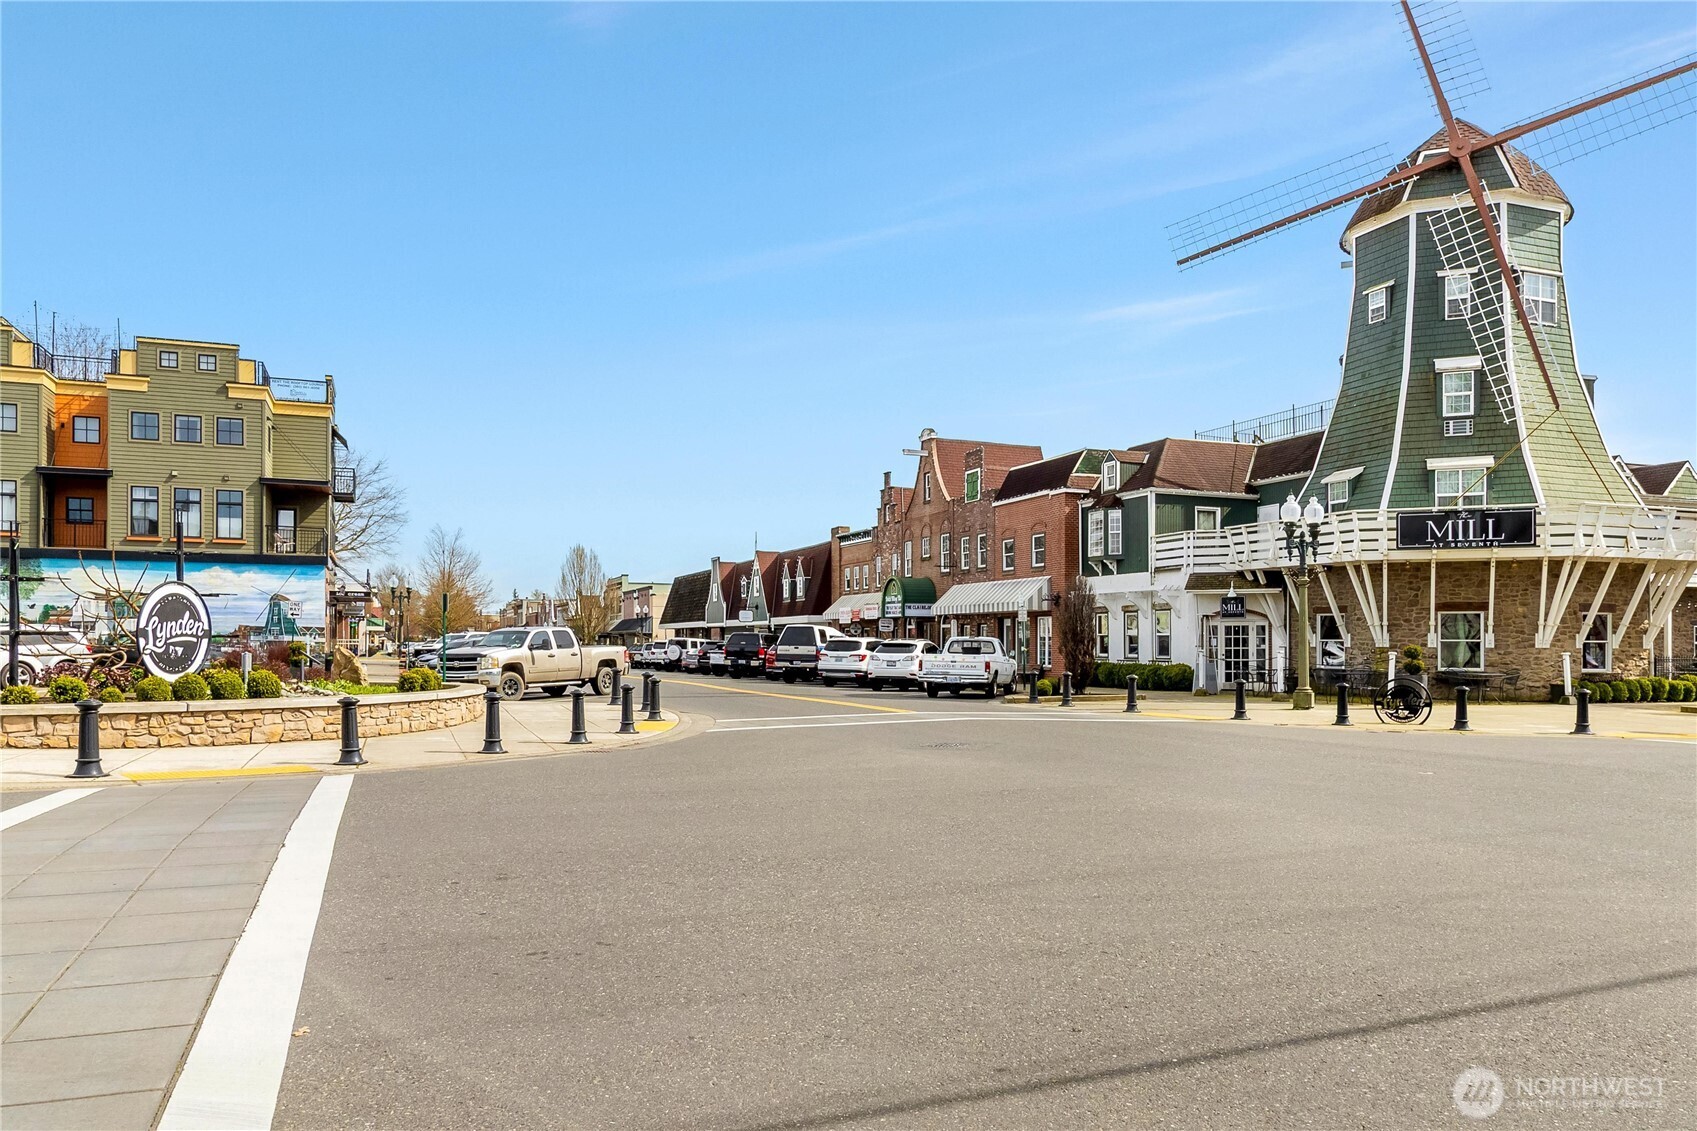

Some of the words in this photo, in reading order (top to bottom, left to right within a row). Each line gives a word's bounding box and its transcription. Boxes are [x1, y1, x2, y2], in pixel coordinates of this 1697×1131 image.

[1426, 518, 1505, 542] MILL
[144, 610, 204, 654] Lynden
[1380, 694, 1425, 714] Lynden
